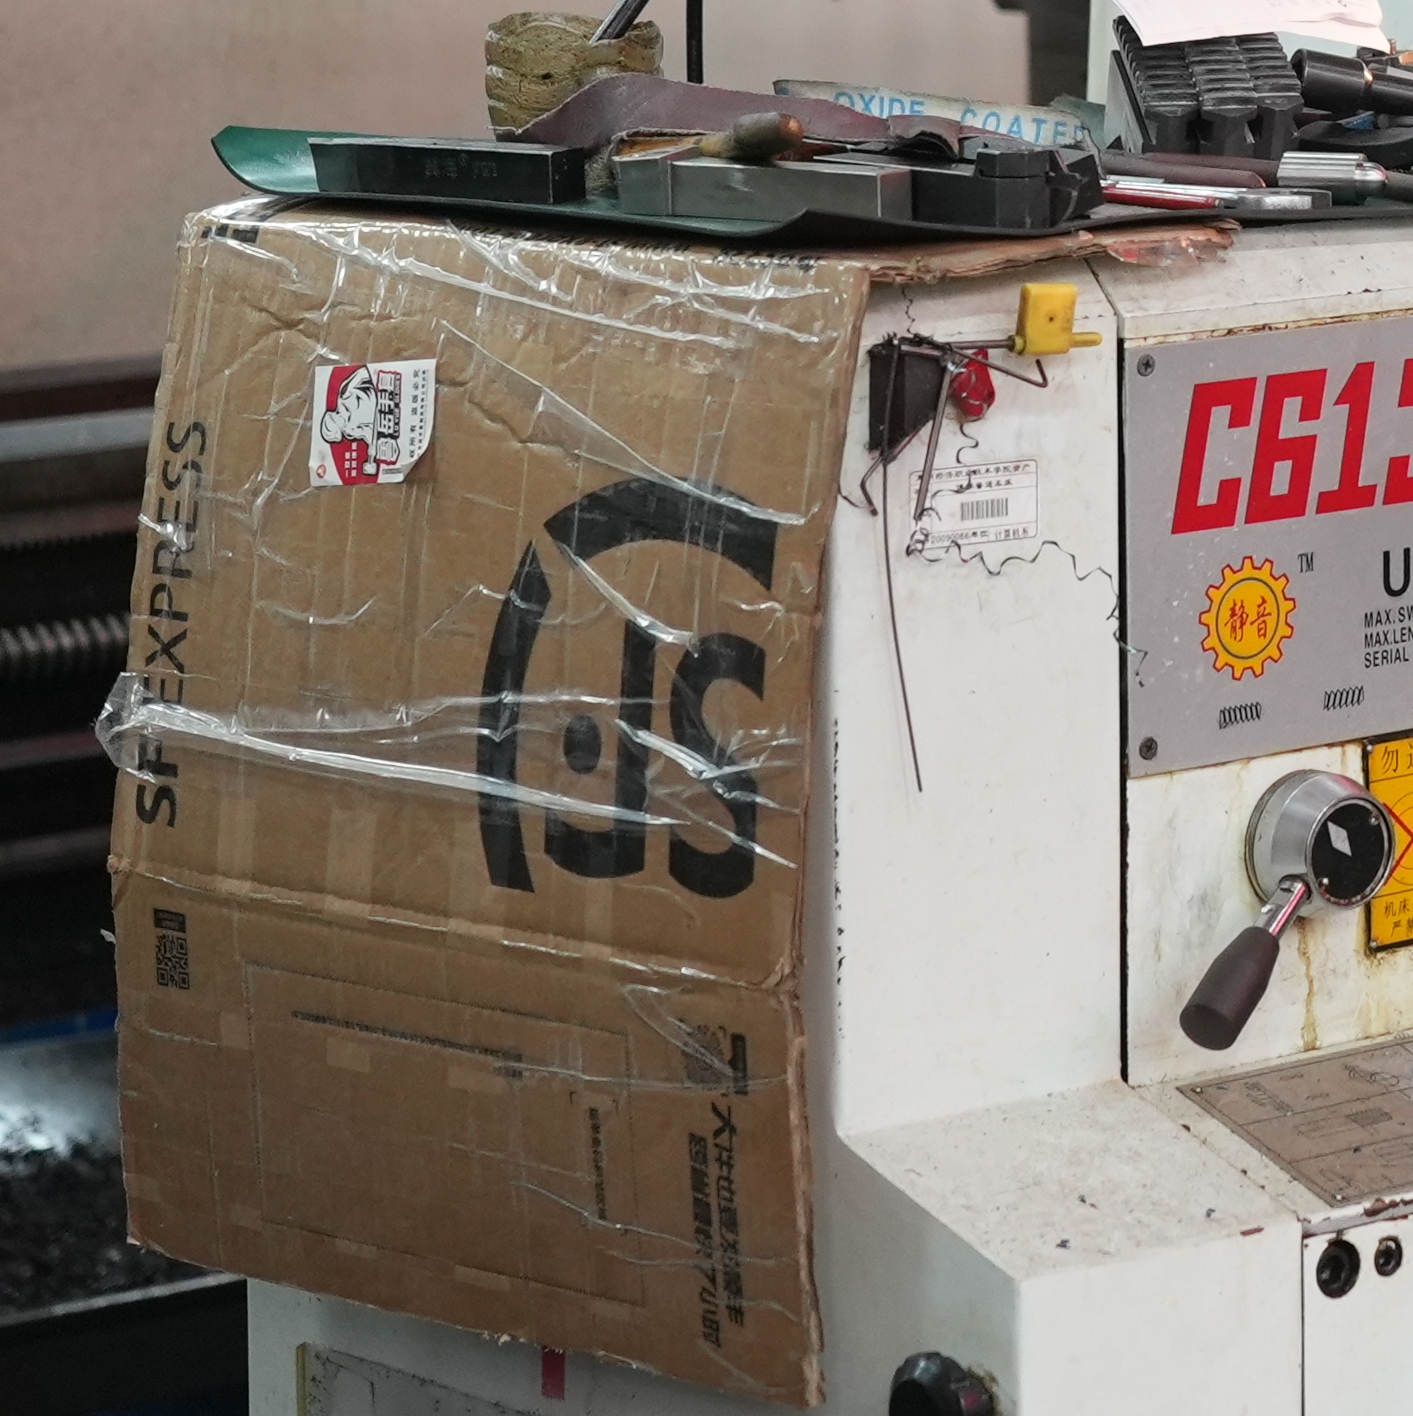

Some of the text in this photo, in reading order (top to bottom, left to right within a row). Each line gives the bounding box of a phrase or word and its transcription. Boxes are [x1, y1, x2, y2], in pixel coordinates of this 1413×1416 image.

[145, 421, 207, 705] EXPRESS
[1298, 551, 1314, 573] TM
[1224, 596, 1272, 642] 静音
[1364, 645, 1409, 668] SERIAL
